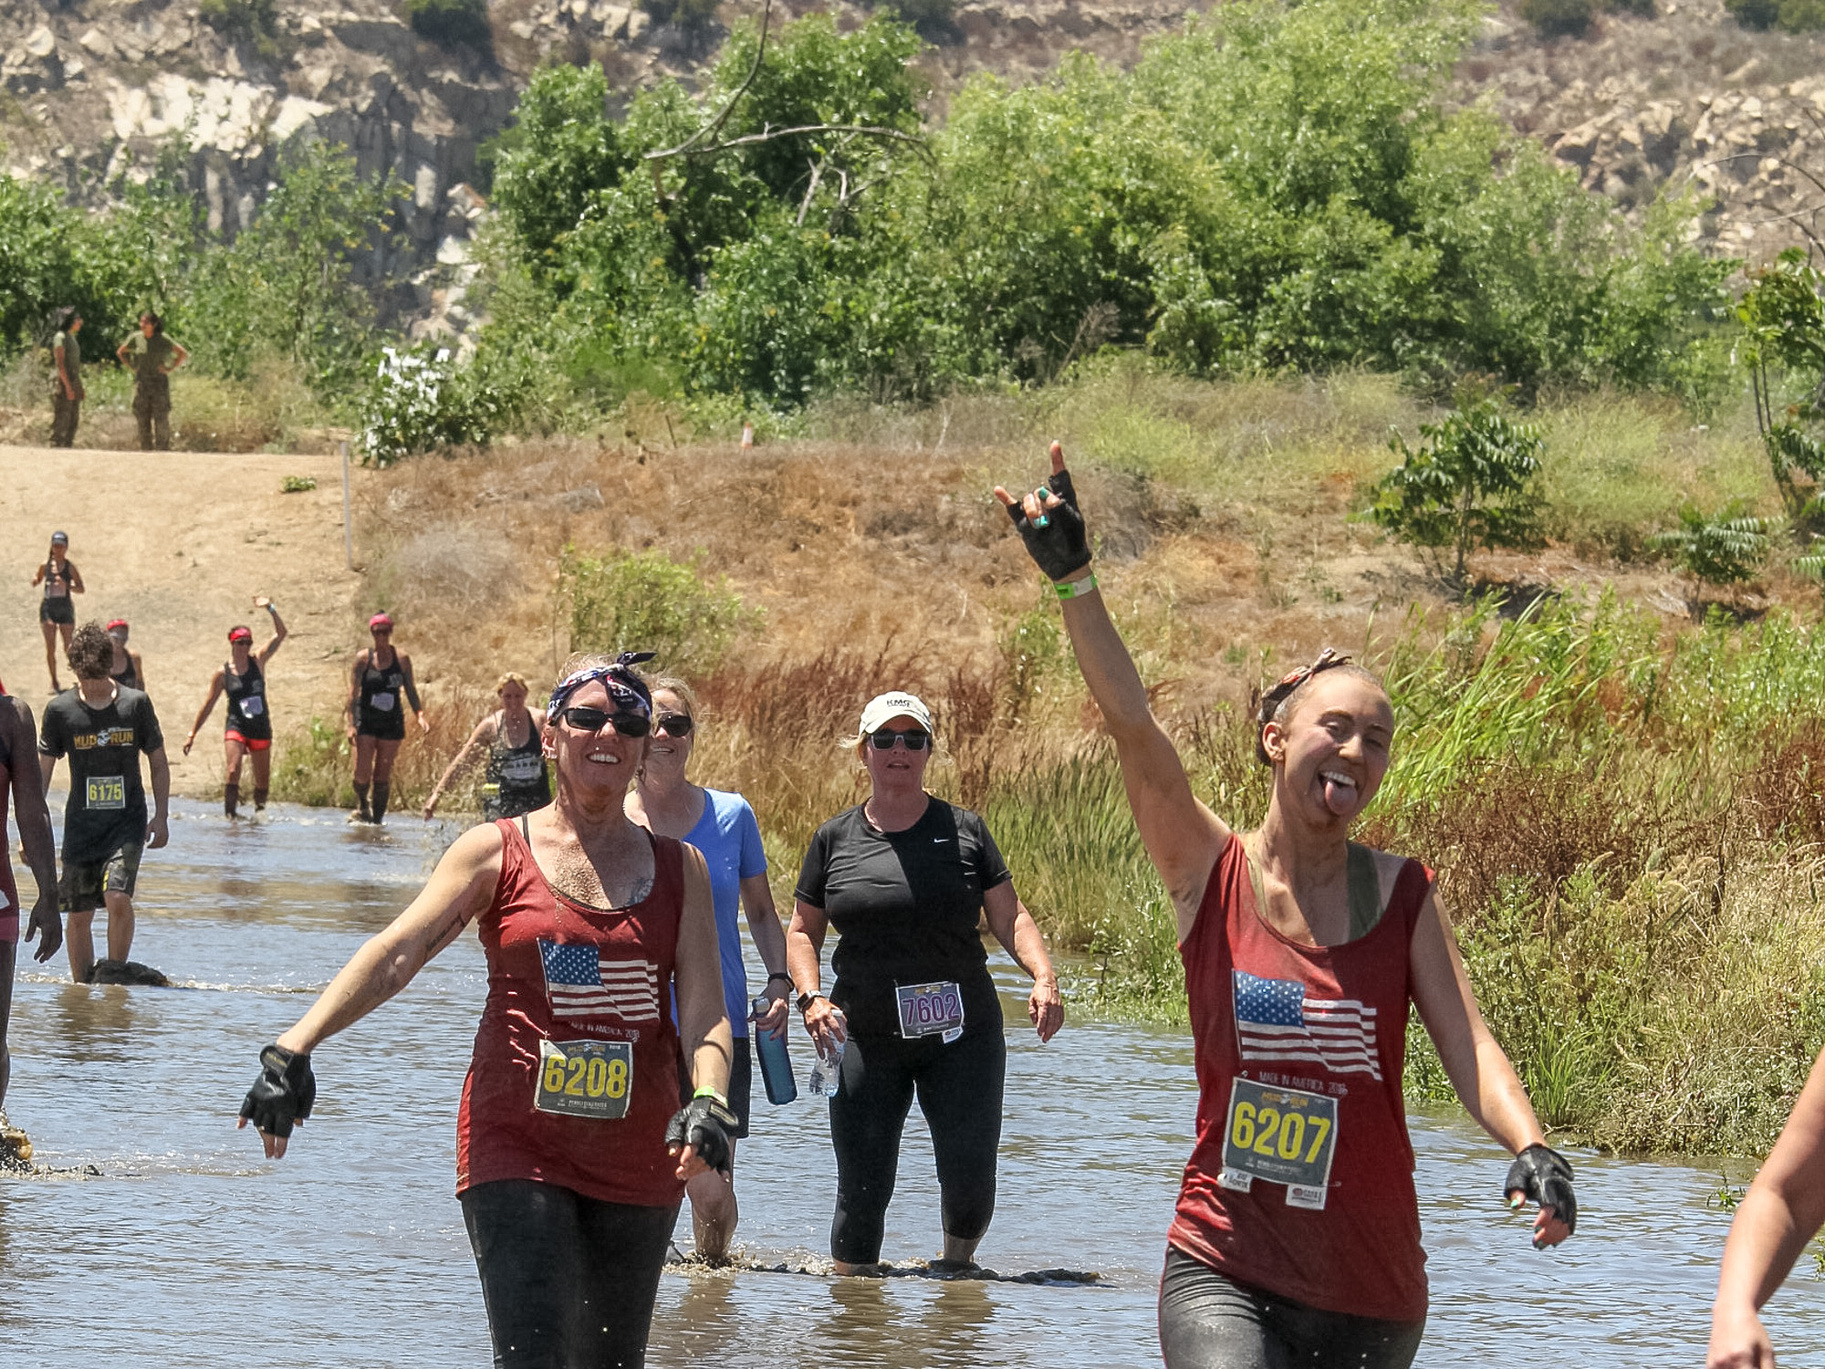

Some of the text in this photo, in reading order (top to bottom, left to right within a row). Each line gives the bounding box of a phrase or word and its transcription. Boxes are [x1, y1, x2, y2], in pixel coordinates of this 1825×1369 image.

[74, 731, 133, 748] MUD RUN
[89, 784, 122, 801] 6175
[901, 992, 960, 1026] 7602
[544, 1053, 628, 1099] 6208
[1232, 1101, 1331, 1164] 6207
